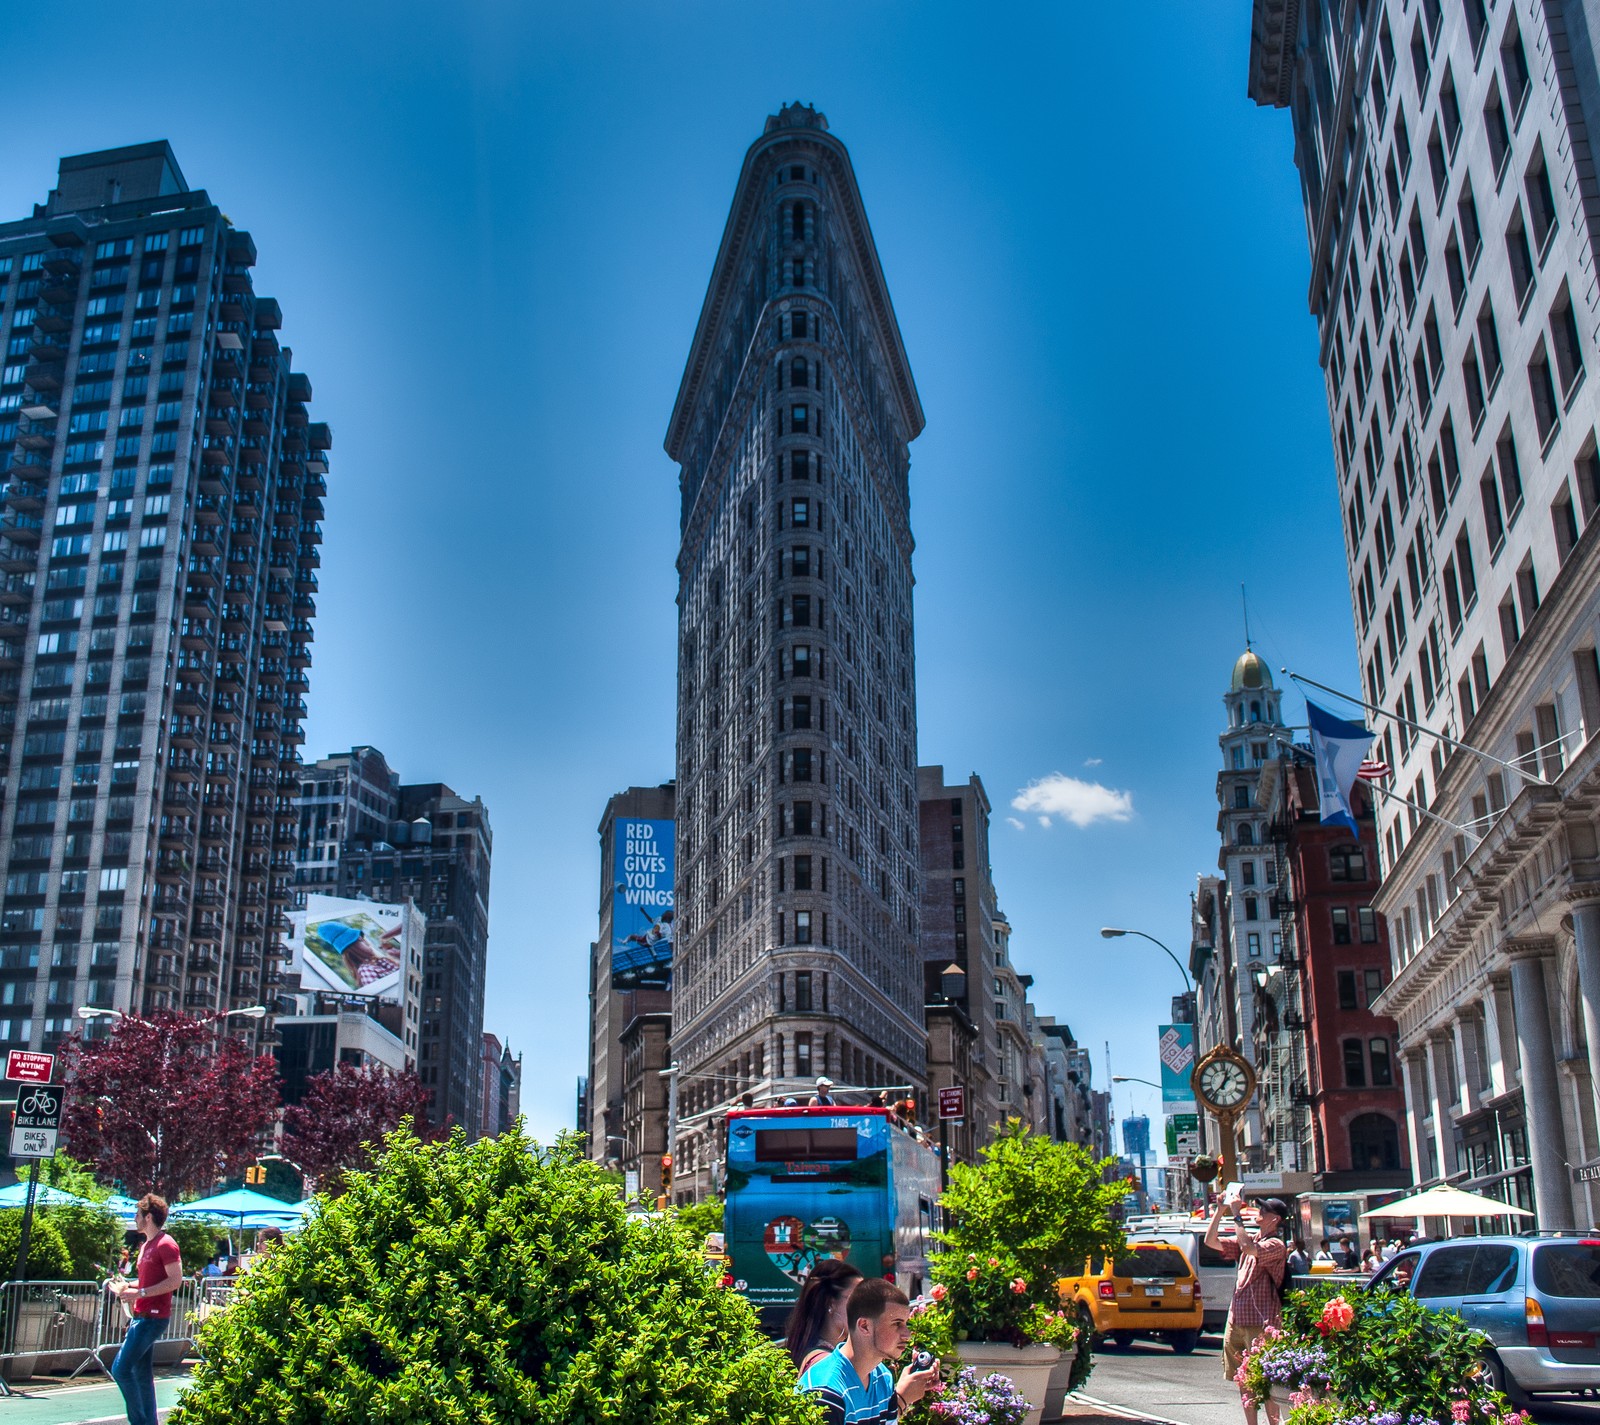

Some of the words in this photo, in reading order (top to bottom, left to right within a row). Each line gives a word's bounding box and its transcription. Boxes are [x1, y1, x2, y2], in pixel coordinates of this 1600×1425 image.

[626, 823, 654, 840] RED
[626, 840, 660, 856] BULL
[624, 856, 666, 873] GIVES
[625, 873, 656, 889] YOU
[625, 890, 674, 906] WINGS
[384, 909, 399, 917] iPad
[23, 1054, 51, 1063] STOPPING
[1172, 1048, 1195, 1071] EATS
[16, 1062, 45, 1071] ANYTIME
[17, 1116, 34, 1125] BIKE
[36, 1117, 57, 1126] LANE
[830, 1118, 849, 1128] 71405
[24, 1131, 46, 1140] BIKES
[23, 1143, 43, 1152] ONLY
[784, 1161, 830, 1172] Taiwan
